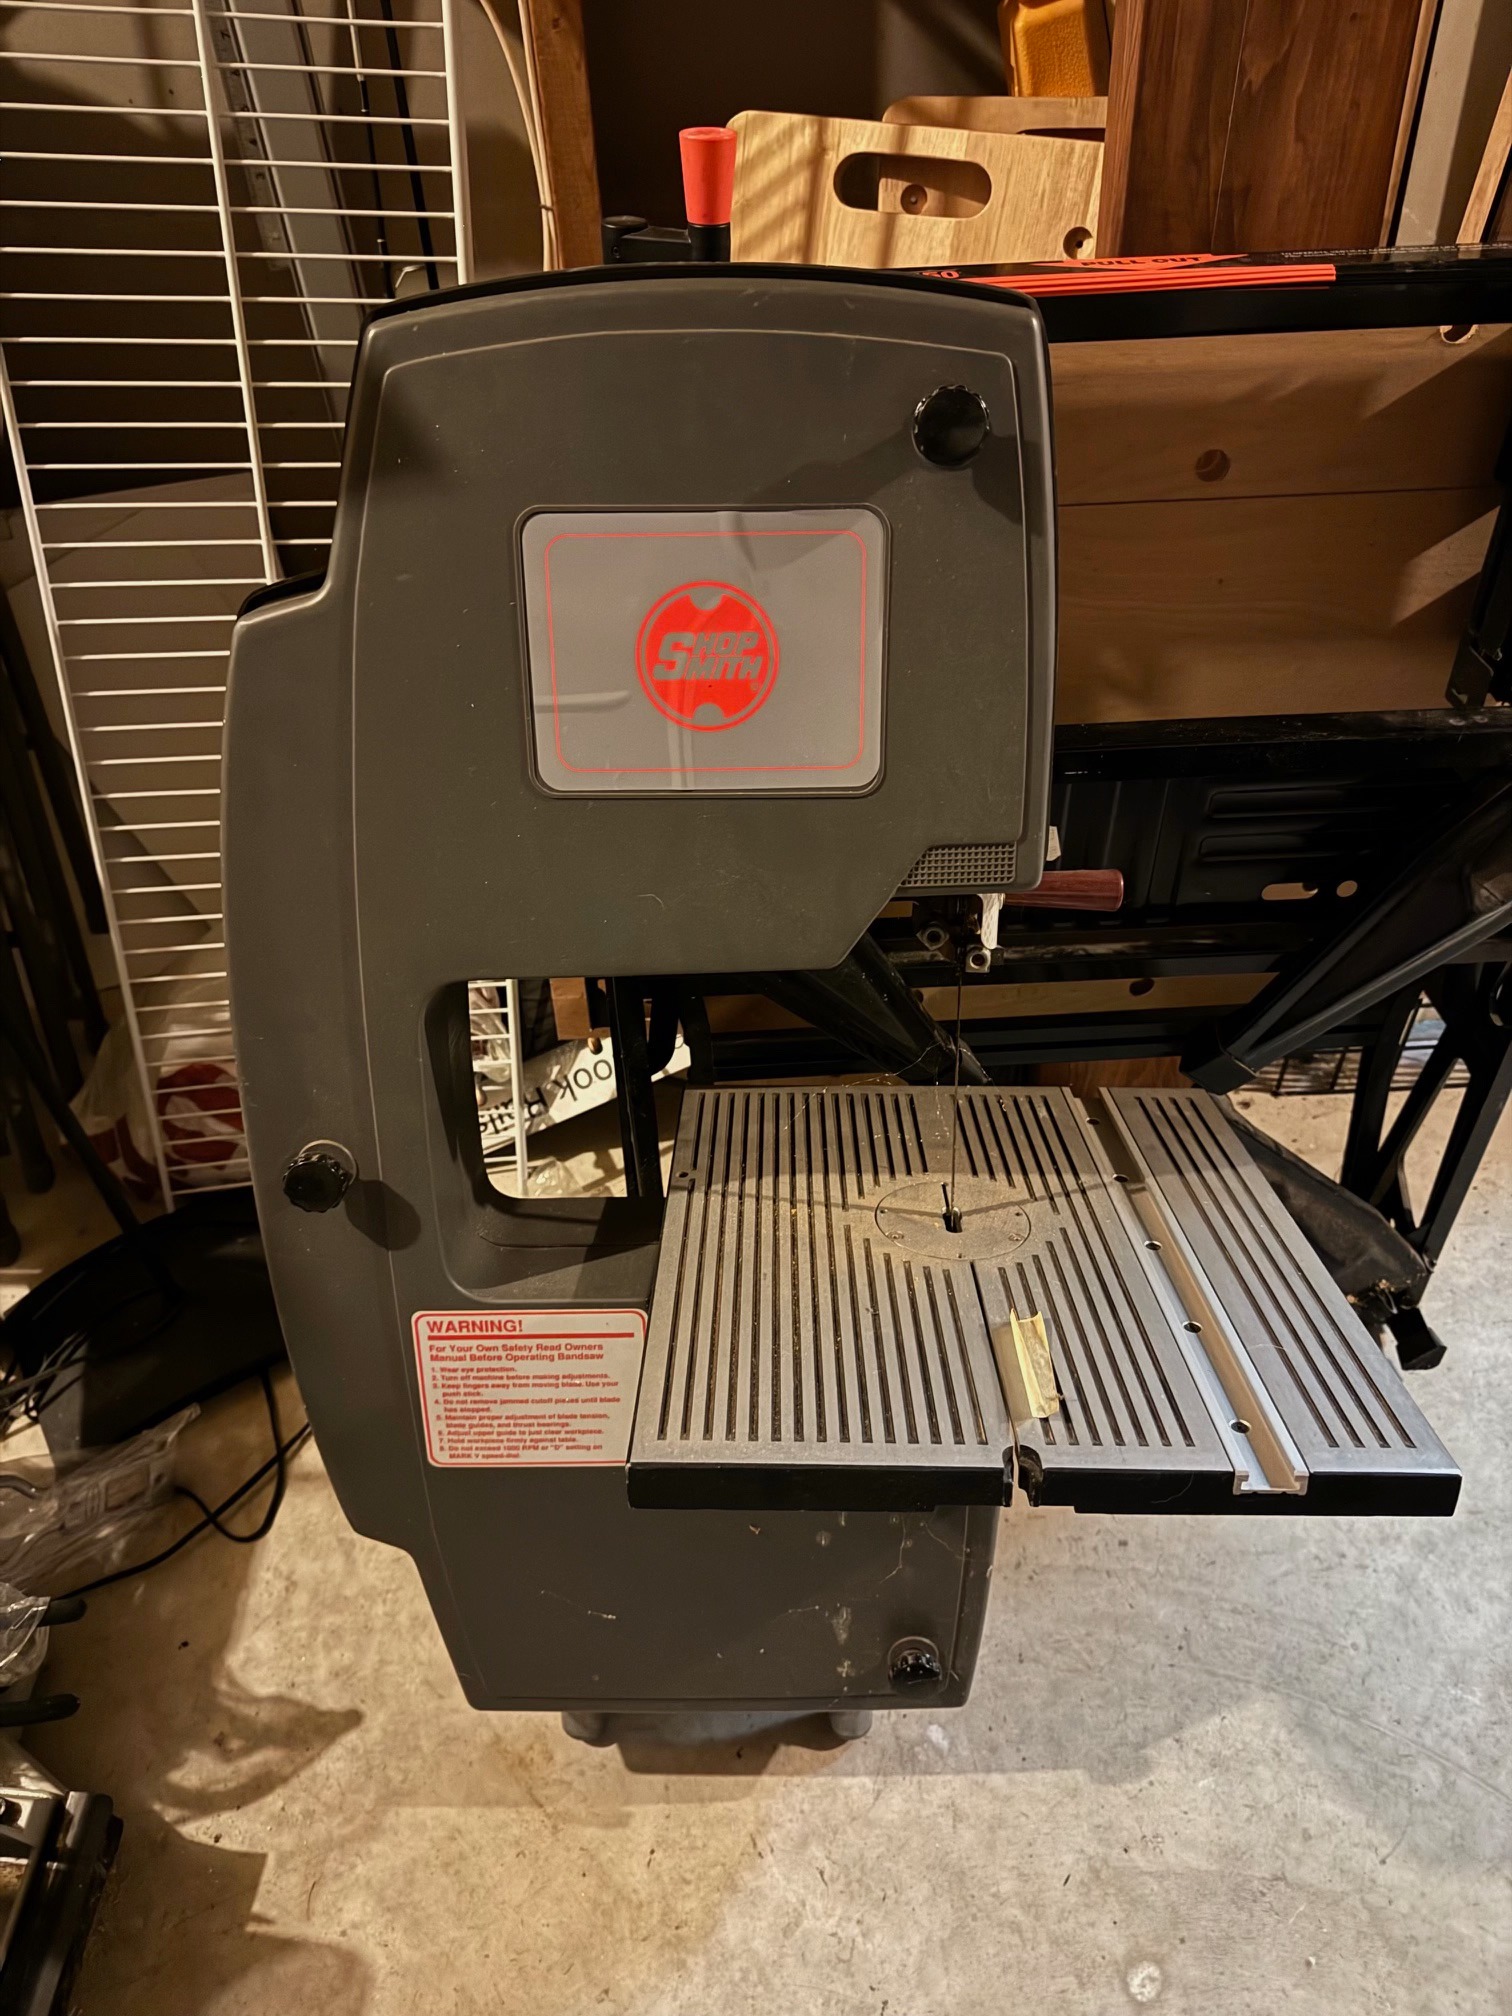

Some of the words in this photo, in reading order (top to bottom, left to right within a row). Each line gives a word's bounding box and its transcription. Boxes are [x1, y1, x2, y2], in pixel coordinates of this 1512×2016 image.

[1151, 256, 1202, 264] OUT
[552, 1058, 613, 1102] ook
[426, 1319, 523, 1333] WARNING!
[449, 1344, 473, 1352] Your
[476, 1344, 499, 1352] Own
[501, 1344, 533, 1353] Safety
[536, 1343, 561, 1351] Read
[564, 1343, 603, 1351] Owners
[505, 1353, 555, 1362] Operating
[557, 1352, 604, 1360] Bandsaw
